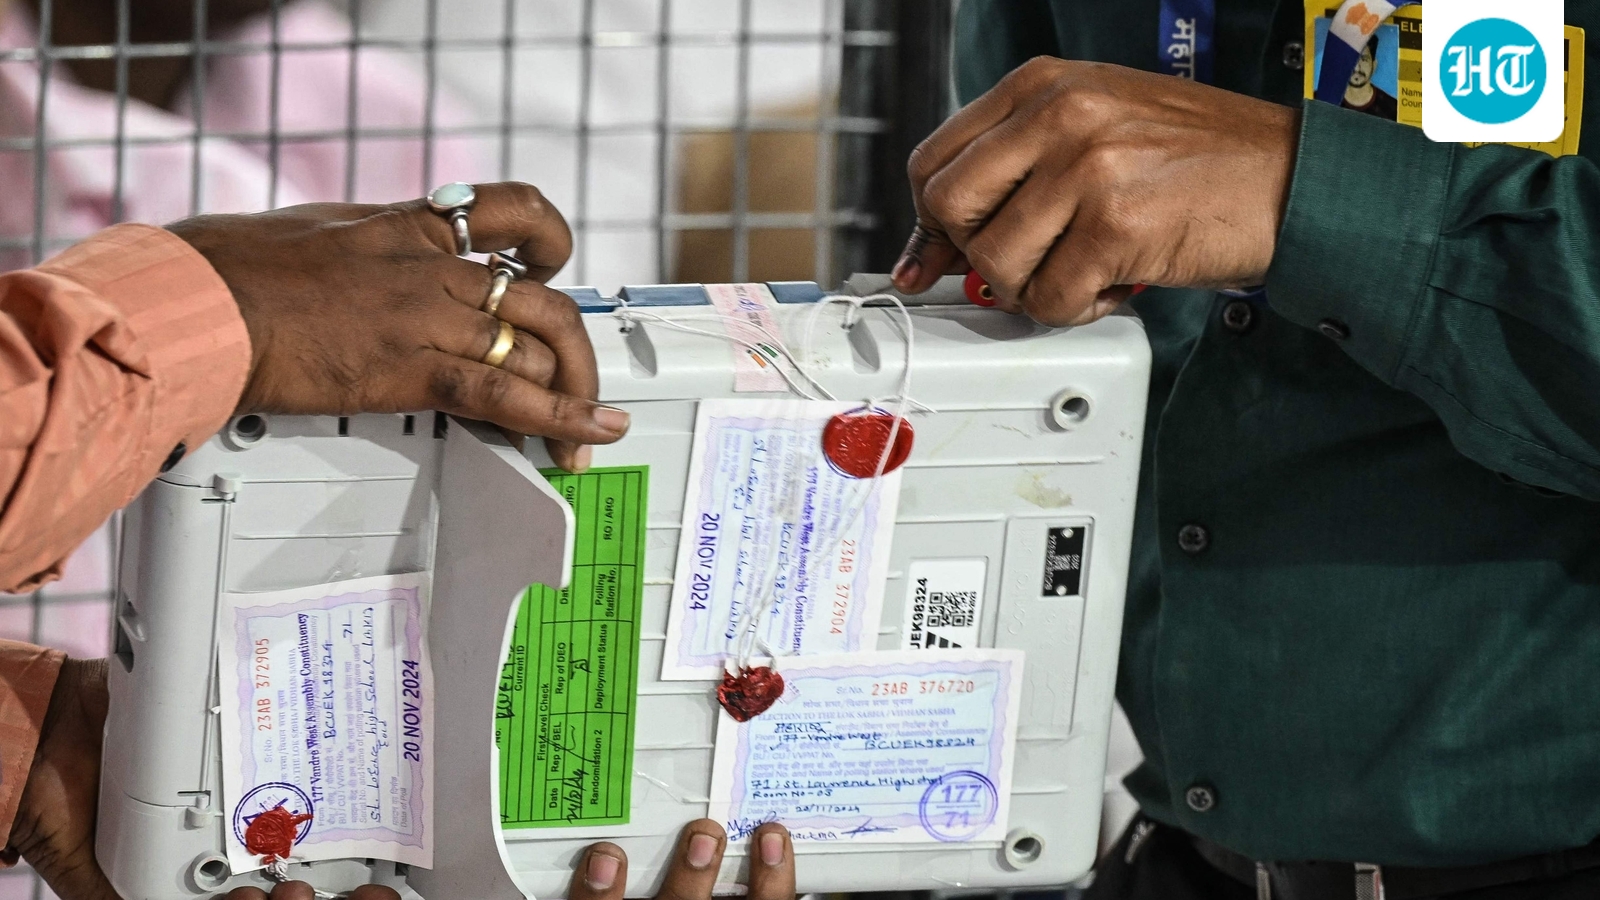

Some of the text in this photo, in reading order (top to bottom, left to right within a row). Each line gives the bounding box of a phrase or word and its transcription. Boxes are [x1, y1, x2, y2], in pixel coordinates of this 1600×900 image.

[805, 466, 818, 484] 177
[605, 497, 614, 519] ARO
[802, 486, 818, 521] Vandre
[603, 526, 613, 540] RO
[689, 513, 720, 610] 20 NOV 2024
[838, 539, 856, 574] 23AB
[559, 587, 569, 605] Dat
[595, 573, 606, 606] Polling
[606, 567, 616, 618] Station No.
[829, 583, 852, 635] 372904
[297, 613, 311, 676] Constituency
[352, 643, 361, 662] used
[254, 638, 270, 689] 372905
[288, 648, 297, 674] SABHA
[514, 645, 524, 692] Current ID
[555, 642, 566, 694] Rep of DEO
[594, 623, 607, 709] Deployment Status
[289, 676, 299, 708] VIDHAN
[301, 679, 315, 722] Assembly
[354, 688, 363, 712] station
[871, 682, 909, 697] 23AB
[919, 680, 975, 694] 376720
[256, 698, 272, 731] 23AB
[402, 660, 420, 762] 20 NOV 2024
[537, 683, 549, 761] First Level Check
[803, 712, 815, 720] TO
[306, 724, 319, 750] West
[356, 714, 365, 737] polling
[292, 741, 300, 756] LOK
[356, 739, 364, 747] of
[308, 750, 321, 784] Vandre
[357, 748, 365, 770] Name
[549, 721, 561, 808] Date Rep of BEL
[590, 737, 602, 805] Randomisation
[337, 764, 345, 788] VVPAT
[311, 786, 323, 803] 177
[337, 794, 346, 806] CU
[358, 789, 366, 800] No.
[753, 790, 788, 800] Room
[941, 784, 982, 803] 177
[338, 813, 347, 824] BU
[359, 802, 367, 823] Serial
[399, 787, 408, 828] Date of Poll
[944, 810, 970, 828] 71
